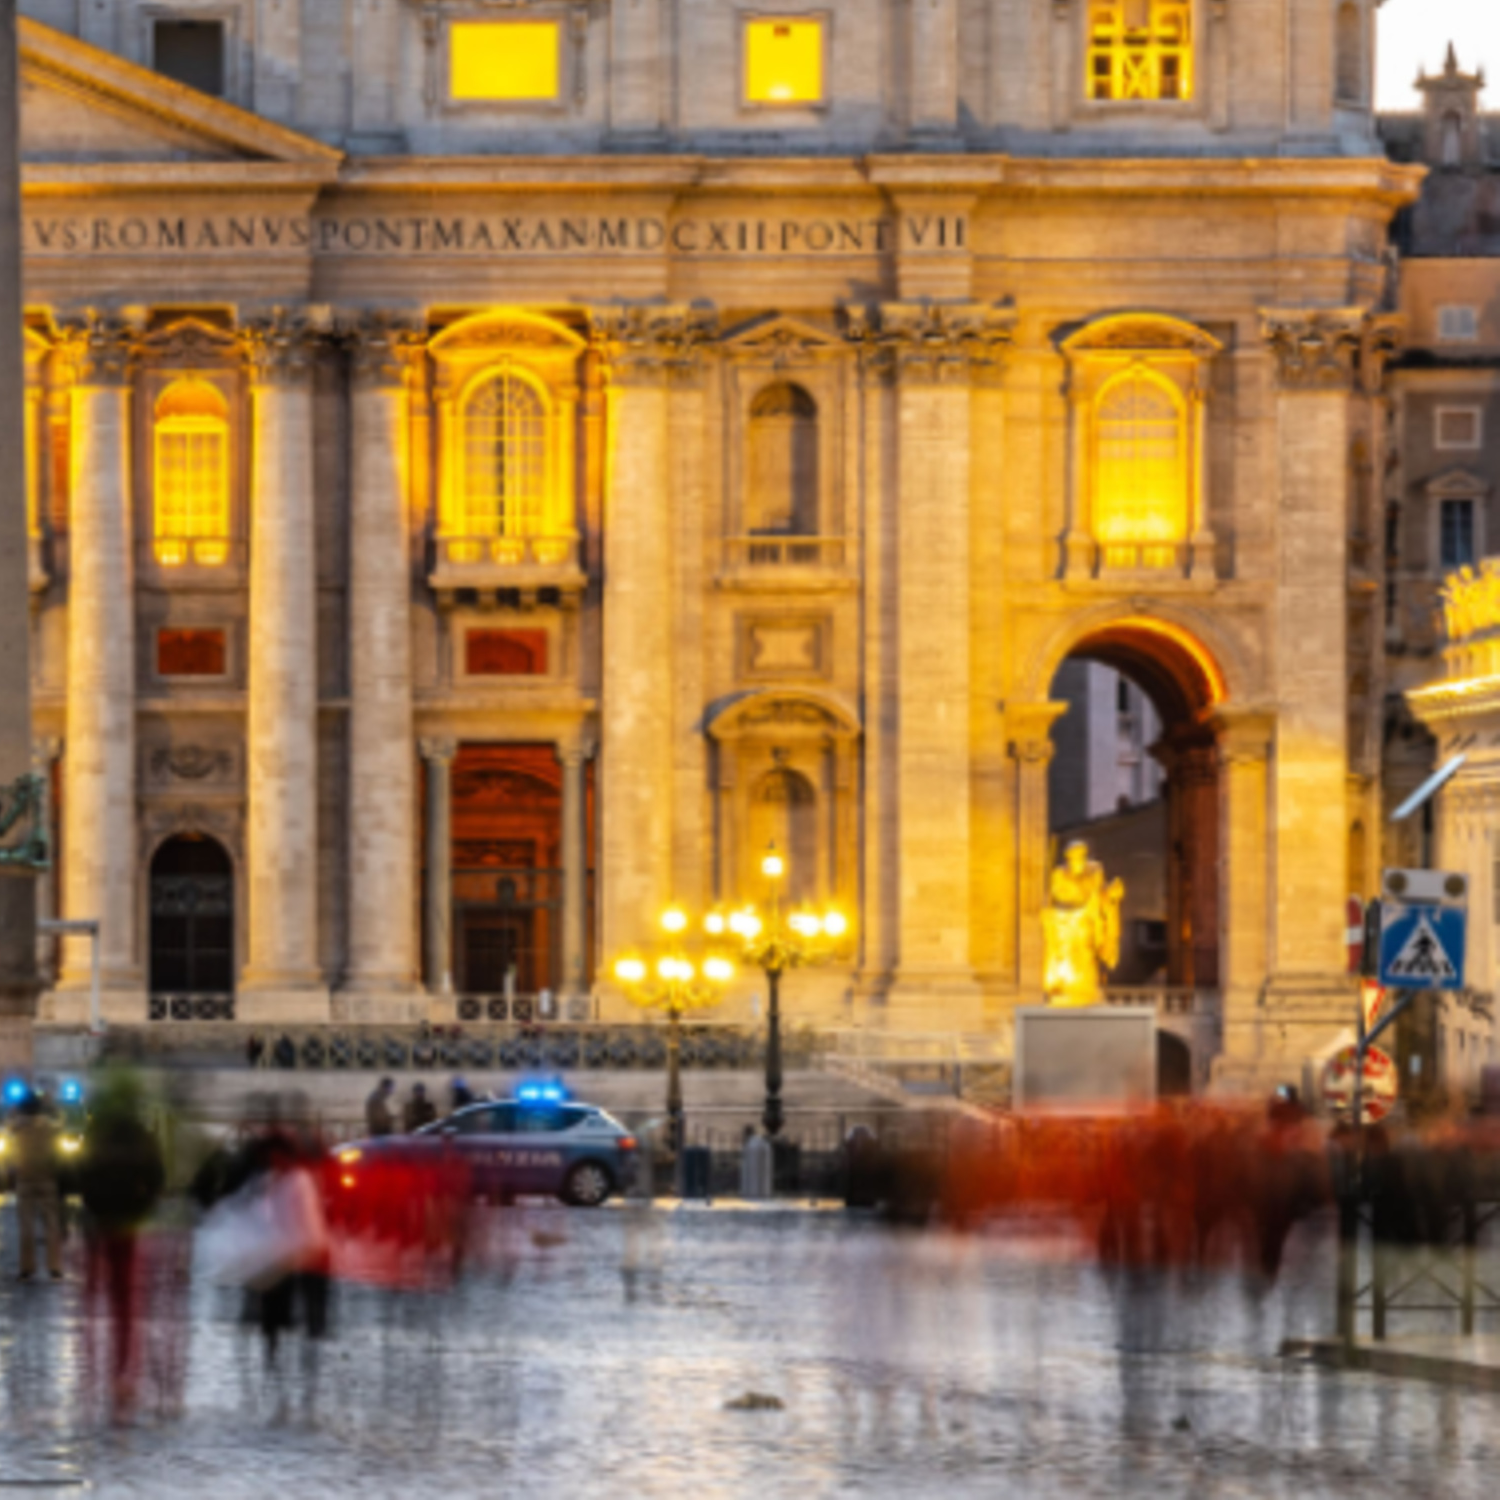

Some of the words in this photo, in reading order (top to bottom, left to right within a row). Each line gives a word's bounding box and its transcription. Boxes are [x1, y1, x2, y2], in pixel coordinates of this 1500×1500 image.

[91, 217, 312, 250] ROMANVS
[318, 218, 427, 250] PONT
[430, 217, 522, 249] MAX
[531, 217, 588, 248] AN
[779, 220, 890, 251] PONT
[905, 216, 966, 247] VII
